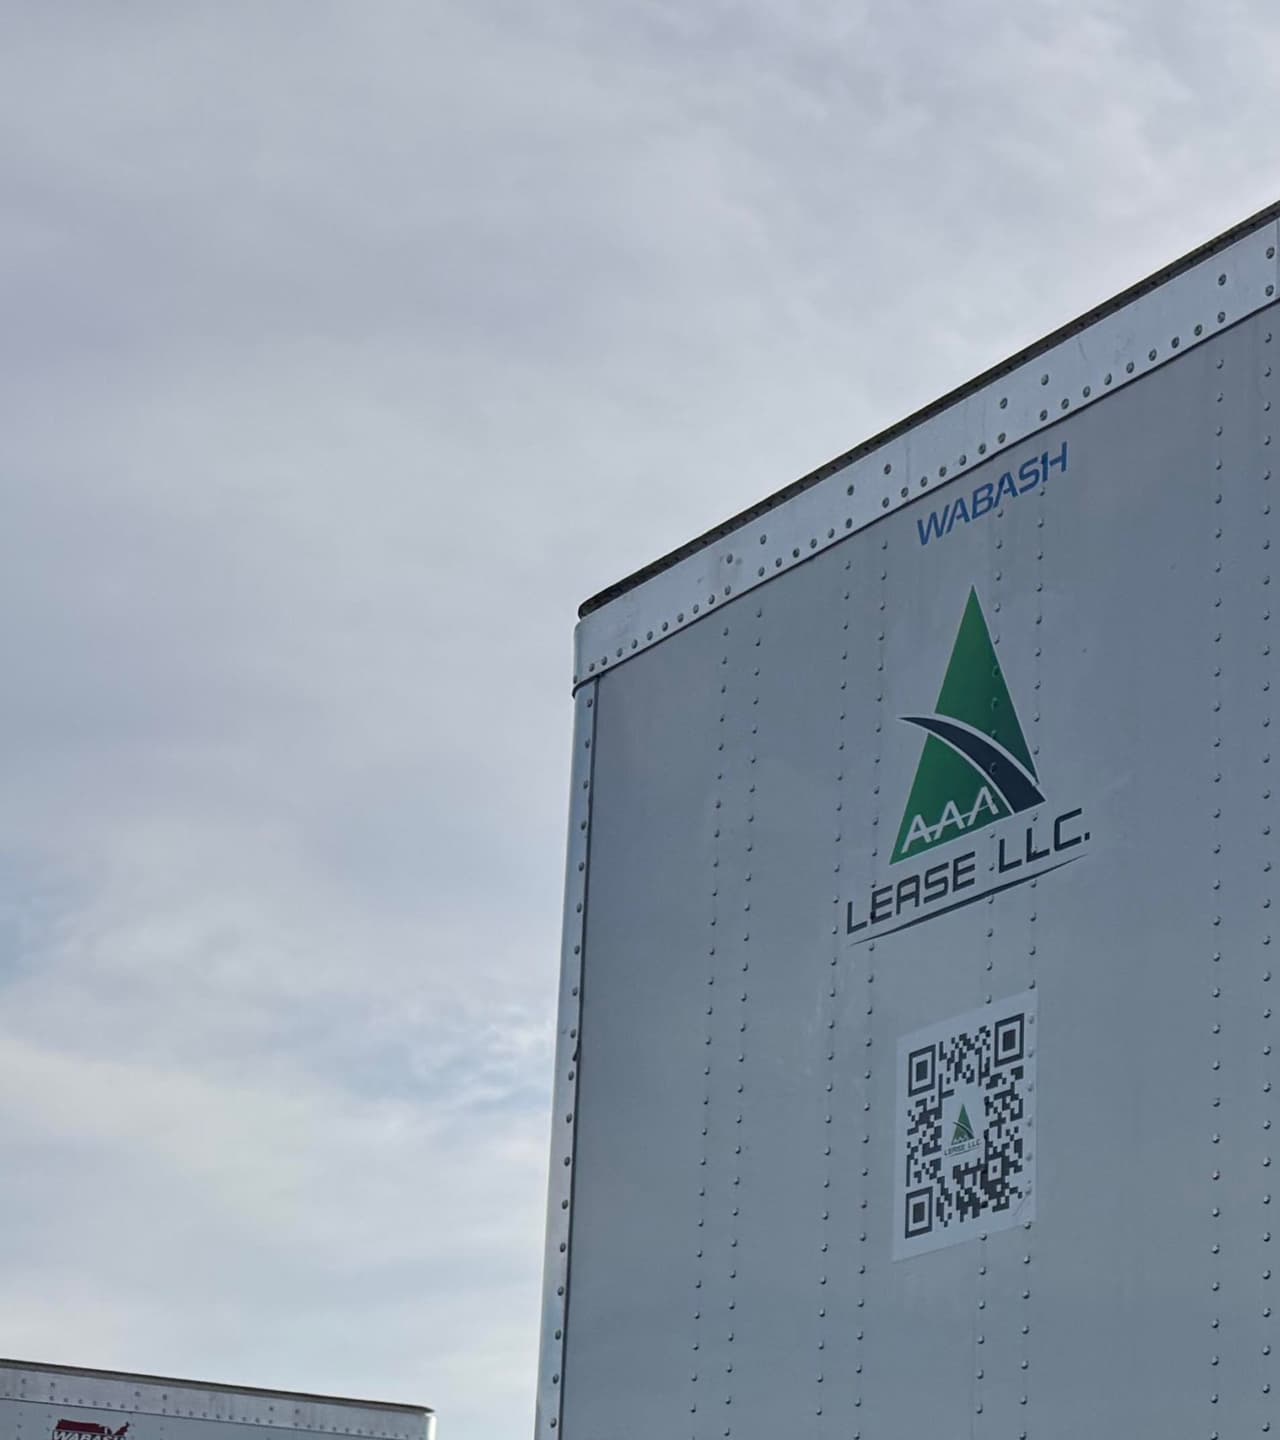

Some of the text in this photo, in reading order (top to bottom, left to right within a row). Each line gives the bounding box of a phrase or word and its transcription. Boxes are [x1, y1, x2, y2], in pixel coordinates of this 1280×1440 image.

[916, 440, 1070, 547] WABASH
[846, 807, 1091, 936] LEASE LLC.
[901, 785, 999, 854] AAA
